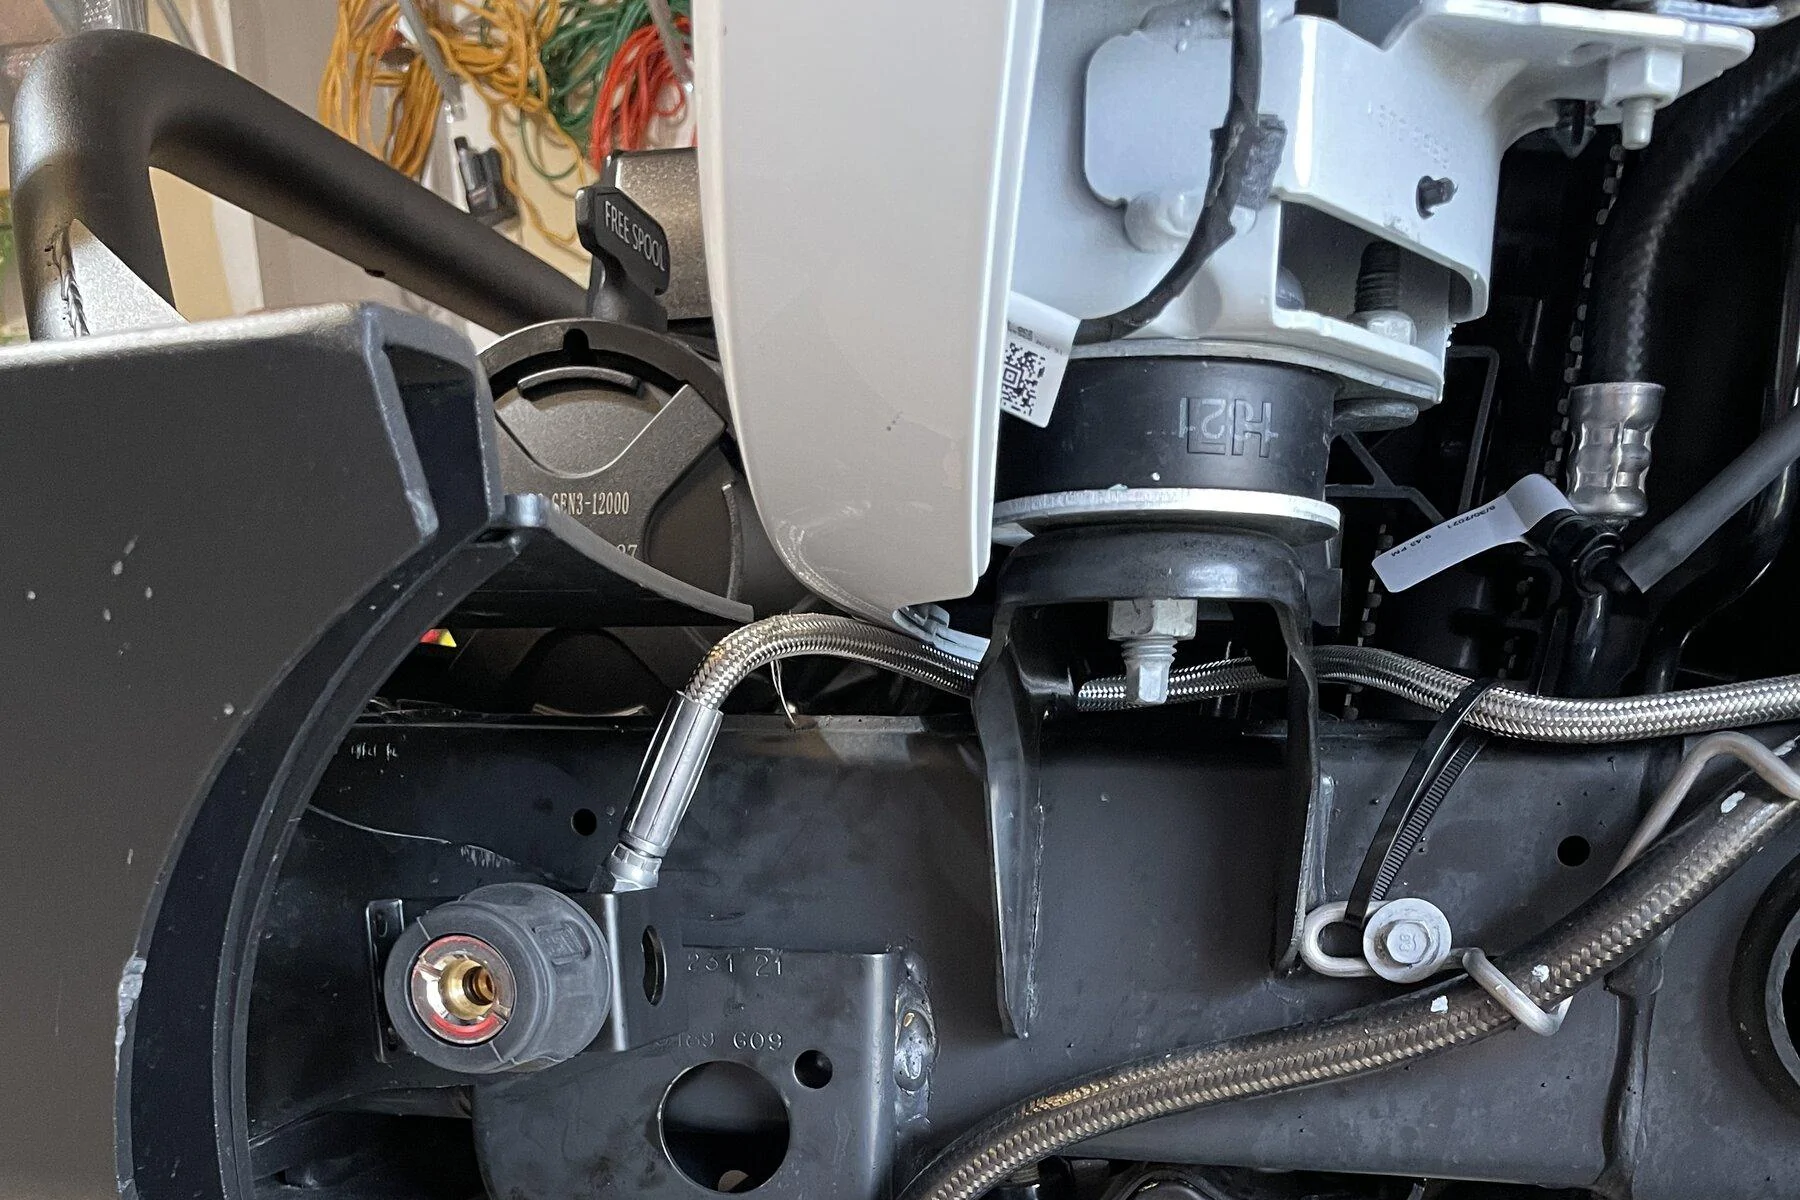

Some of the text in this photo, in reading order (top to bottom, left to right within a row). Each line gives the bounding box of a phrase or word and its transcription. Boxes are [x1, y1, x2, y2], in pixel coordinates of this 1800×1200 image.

[605, 200, 665, 271] FREE SPOOL
[755, 953, 783, 977] 21
